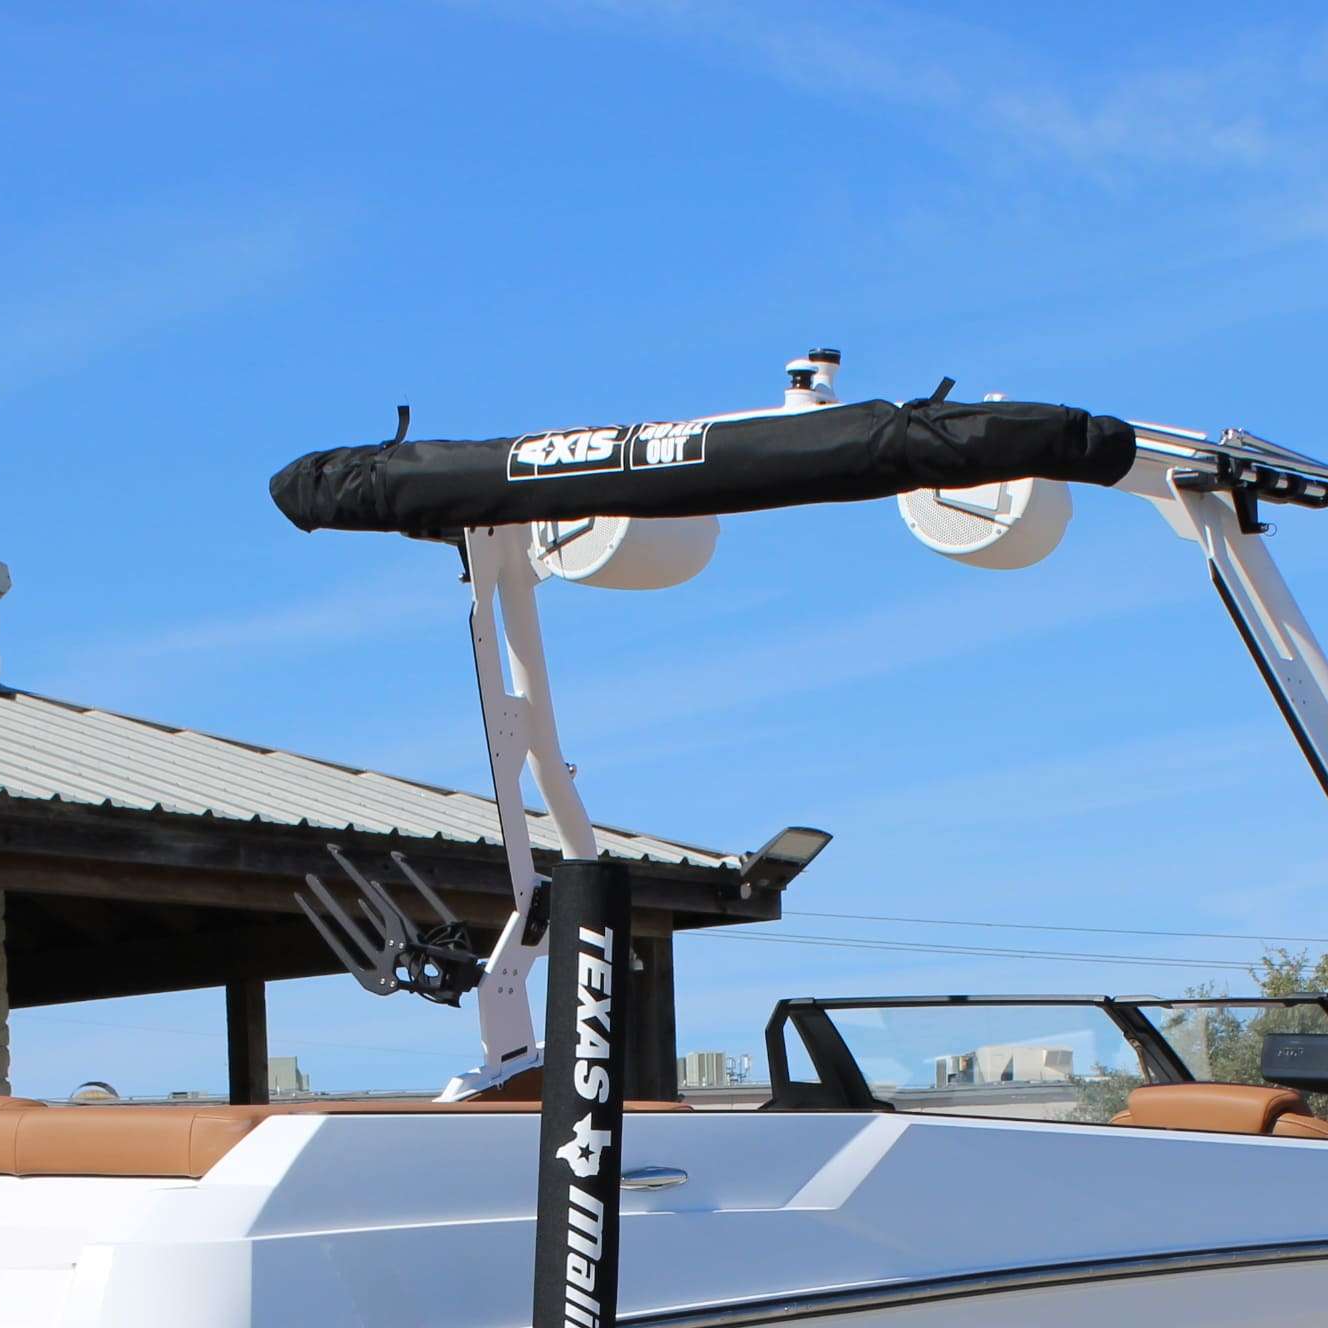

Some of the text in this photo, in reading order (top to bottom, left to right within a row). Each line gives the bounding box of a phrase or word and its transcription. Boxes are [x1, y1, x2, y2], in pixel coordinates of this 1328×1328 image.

[517, 429, 619, 466] AXIS
[646, 435, 690, 464] OUT
[574, 926, 614, 1103] TEXAS
